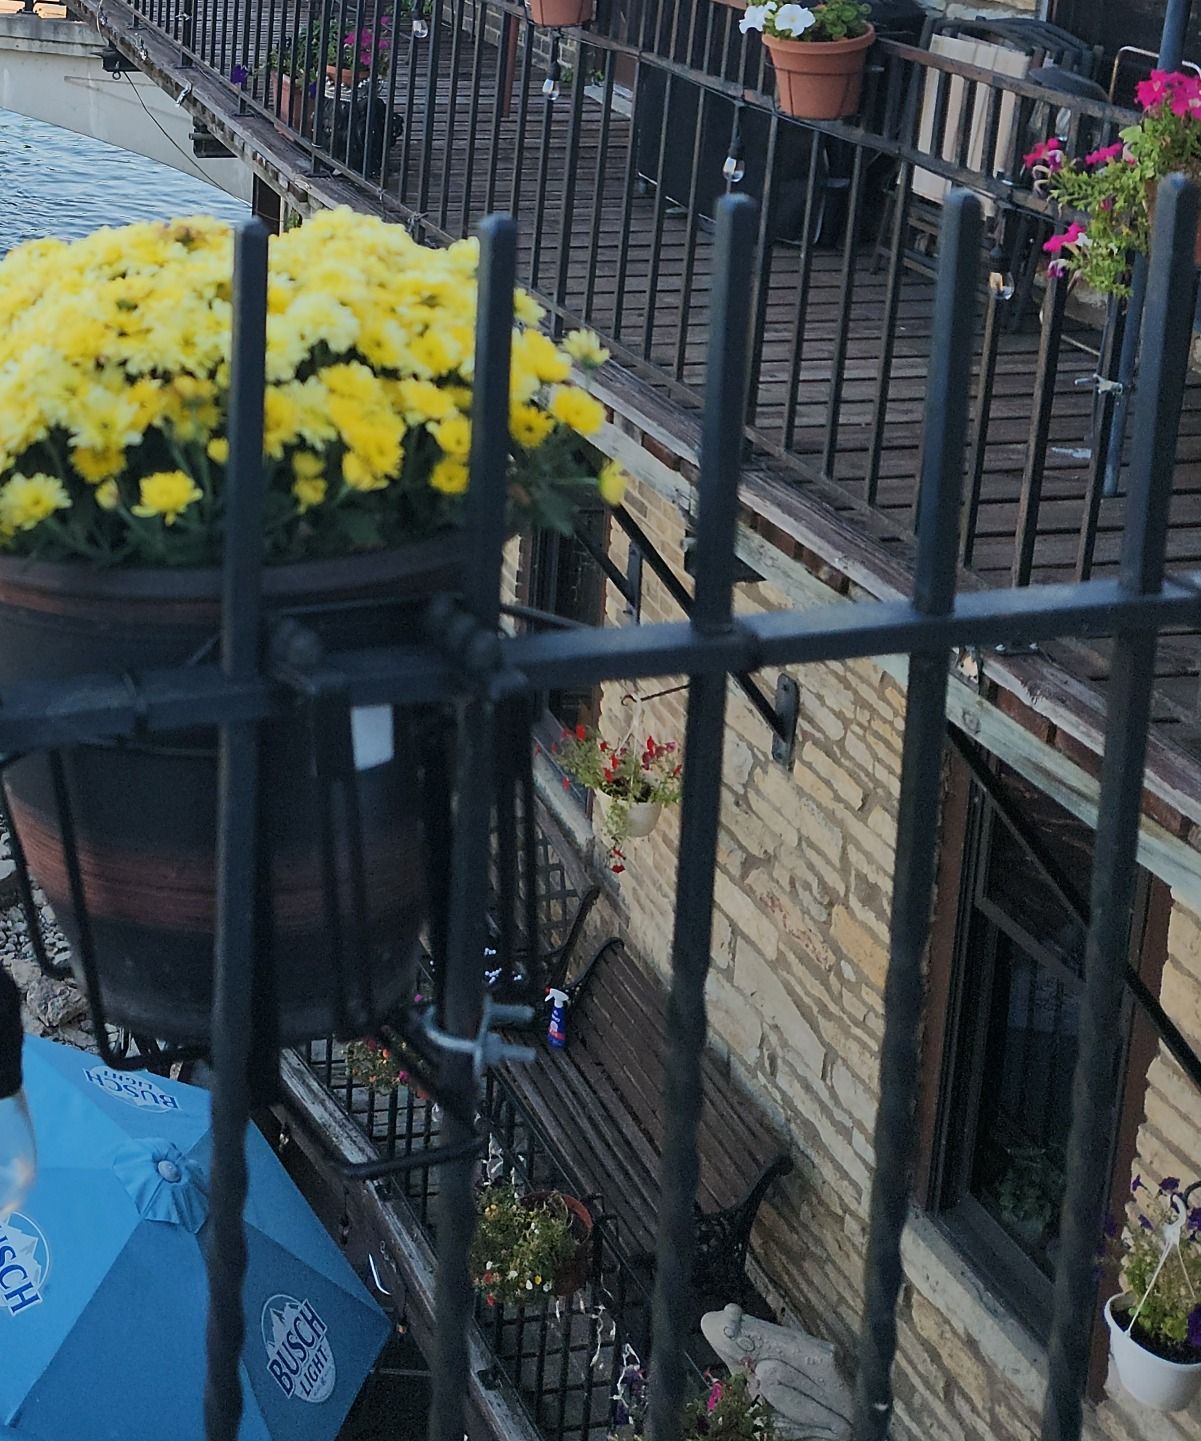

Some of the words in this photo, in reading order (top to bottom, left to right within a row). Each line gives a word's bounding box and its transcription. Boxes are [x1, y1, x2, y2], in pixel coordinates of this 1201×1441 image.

[85, 1070, 179, 1110] BUSCH
[268, 1301, 327, 1396] BUSCH
[300, 1344, 330, 1398] LIGHT
